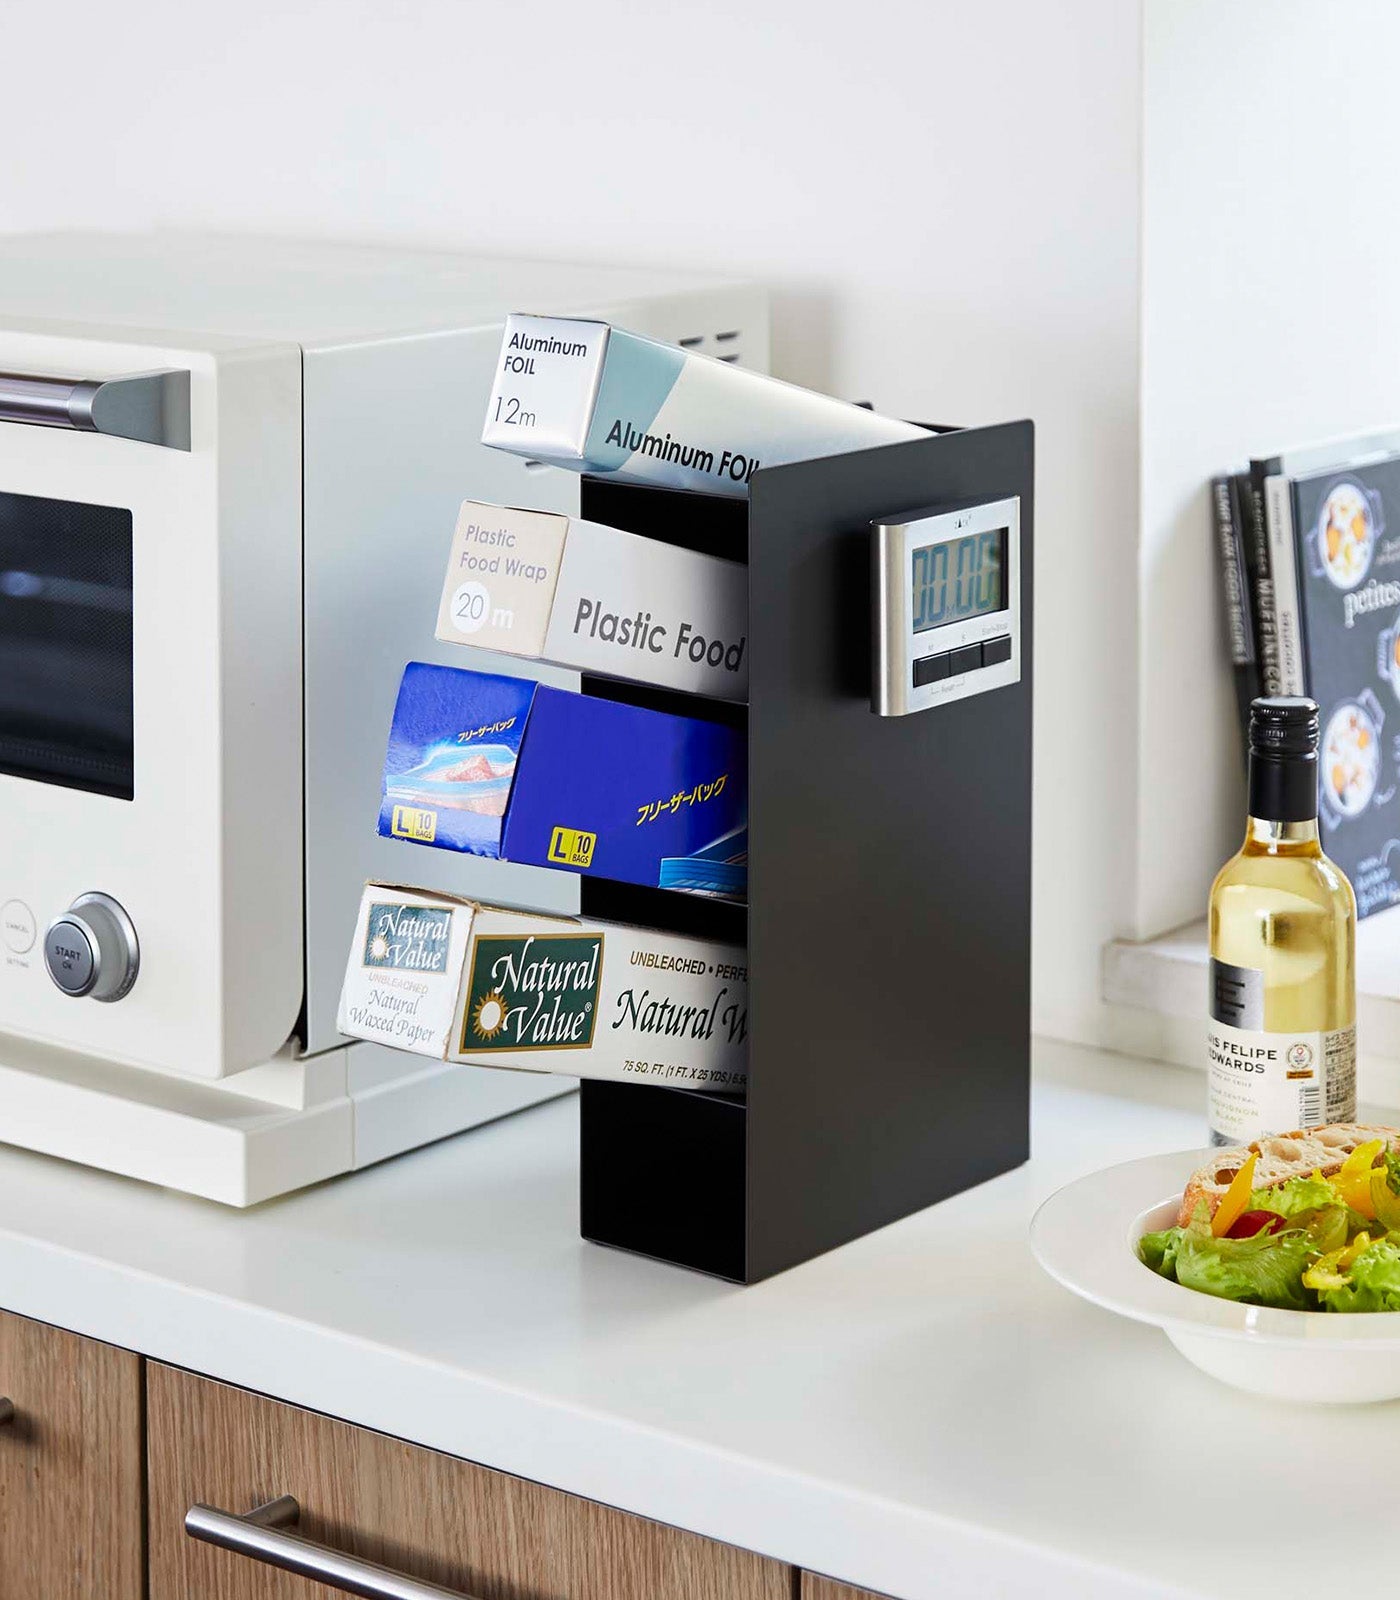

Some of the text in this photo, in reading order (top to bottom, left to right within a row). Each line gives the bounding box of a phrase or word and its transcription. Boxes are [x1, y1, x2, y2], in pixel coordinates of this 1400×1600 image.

[508, 332, 588, 358] Aluminum
[503, 356, 535, 375] FOIL
[494, 396, 536, 428] 12m
[605, 419, 714, 473] Aluminum
[465, 525, 516, 549] Plastic
[460, 552, 548, 583] Food Wrap
[456, 592, 485, 620] 20
[573, 597, 746, 673] Plastic Food
[457, 716, 517, 744] フリーザーバッグ
[635, 773, 729, 827] フリーザーバッグ
[394, 806, 432, 835] L 10
[415, 829, 433, 841] BAGS
[551, 832, 592, 859] L 10
[572, 853, 589, 865] BAGS
[379, 905, 451, 940] Natural
[55, 945, 81, 961] START
[62, 960, 72, 970] OK
[491, 935, 600, 995] Natural
[630, 950, 706, 976] UNBLEACHED
[368, 971, 429, 995] UNBLEACHED
[368, 989, 423, 1016] Natural
[612, 987, 728, 1041] Natural
[349, 1007, 435, 1047] Waxed Paper
[1209, 1046, 1266, 1074] EDWARDS
[1223, 1041, 1278, 1061] FELIPE
[622, 1060, 635, 1072] 75
[635, 1061, 649, 1074] SQ.
[651, 1063, 664, 1075] FT.
[675, 1066, 688, 1078] FT.
[689, 1068, 698, 1079] X
[698, 1069, 709, 1081] 25
